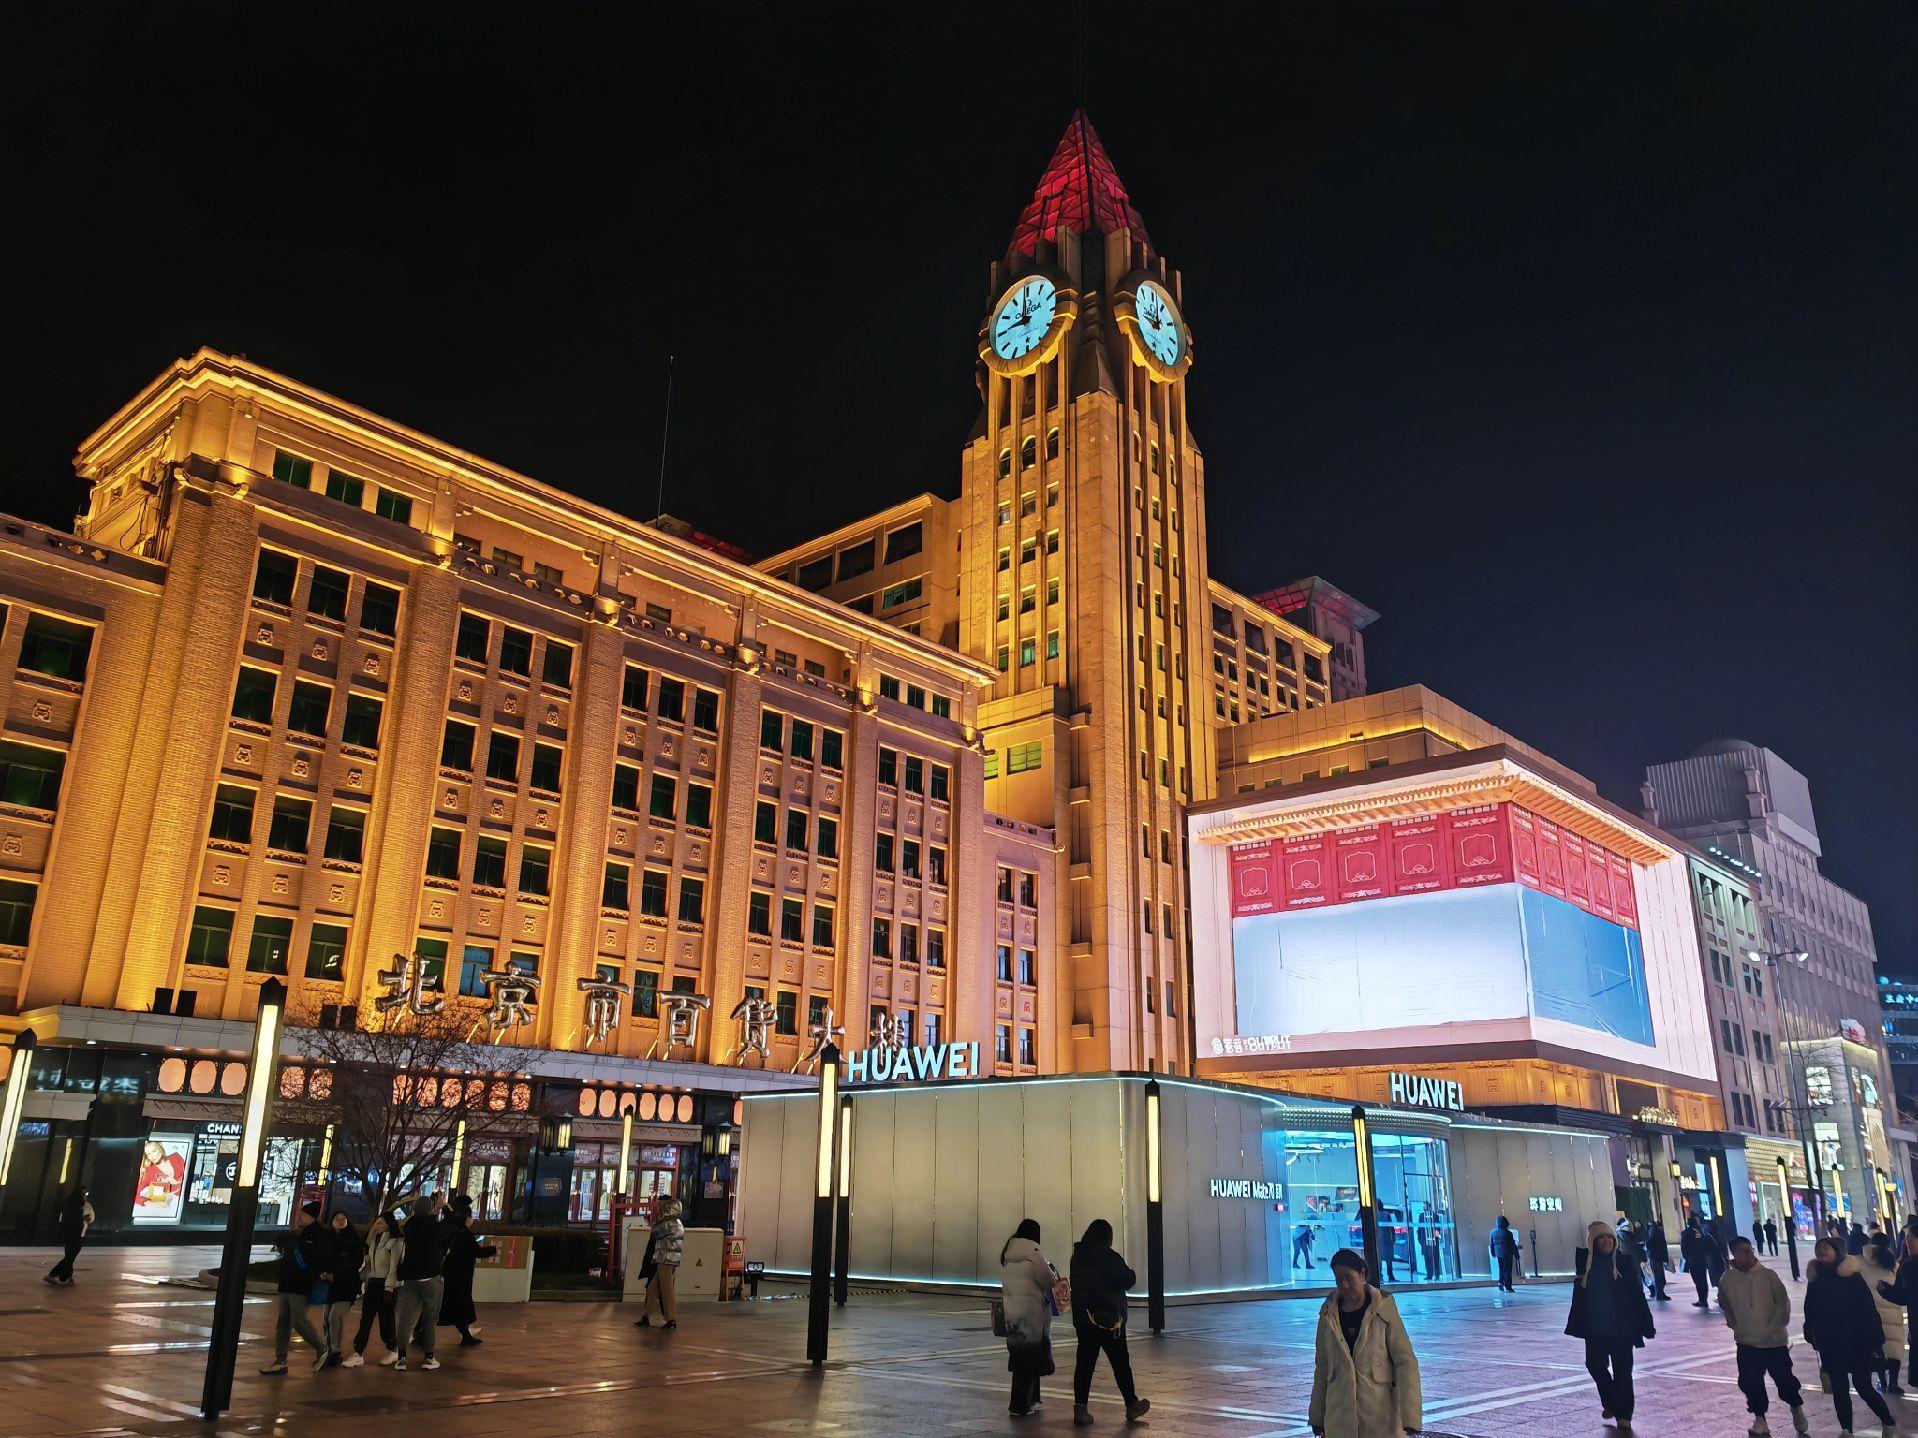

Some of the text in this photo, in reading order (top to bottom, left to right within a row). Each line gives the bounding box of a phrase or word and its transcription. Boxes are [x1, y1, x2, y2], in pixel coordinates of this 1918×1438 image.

[1015, 302, 1042, 320] OEGA
[375, 951, 906, 1067] 北京市百货大楼
[848, 1041, 980, 1084] HUAWEI
[1390, 1071, 1465, 1111] HUAWEI
[1210, 1179, 1251, 1198] HUAWEI
